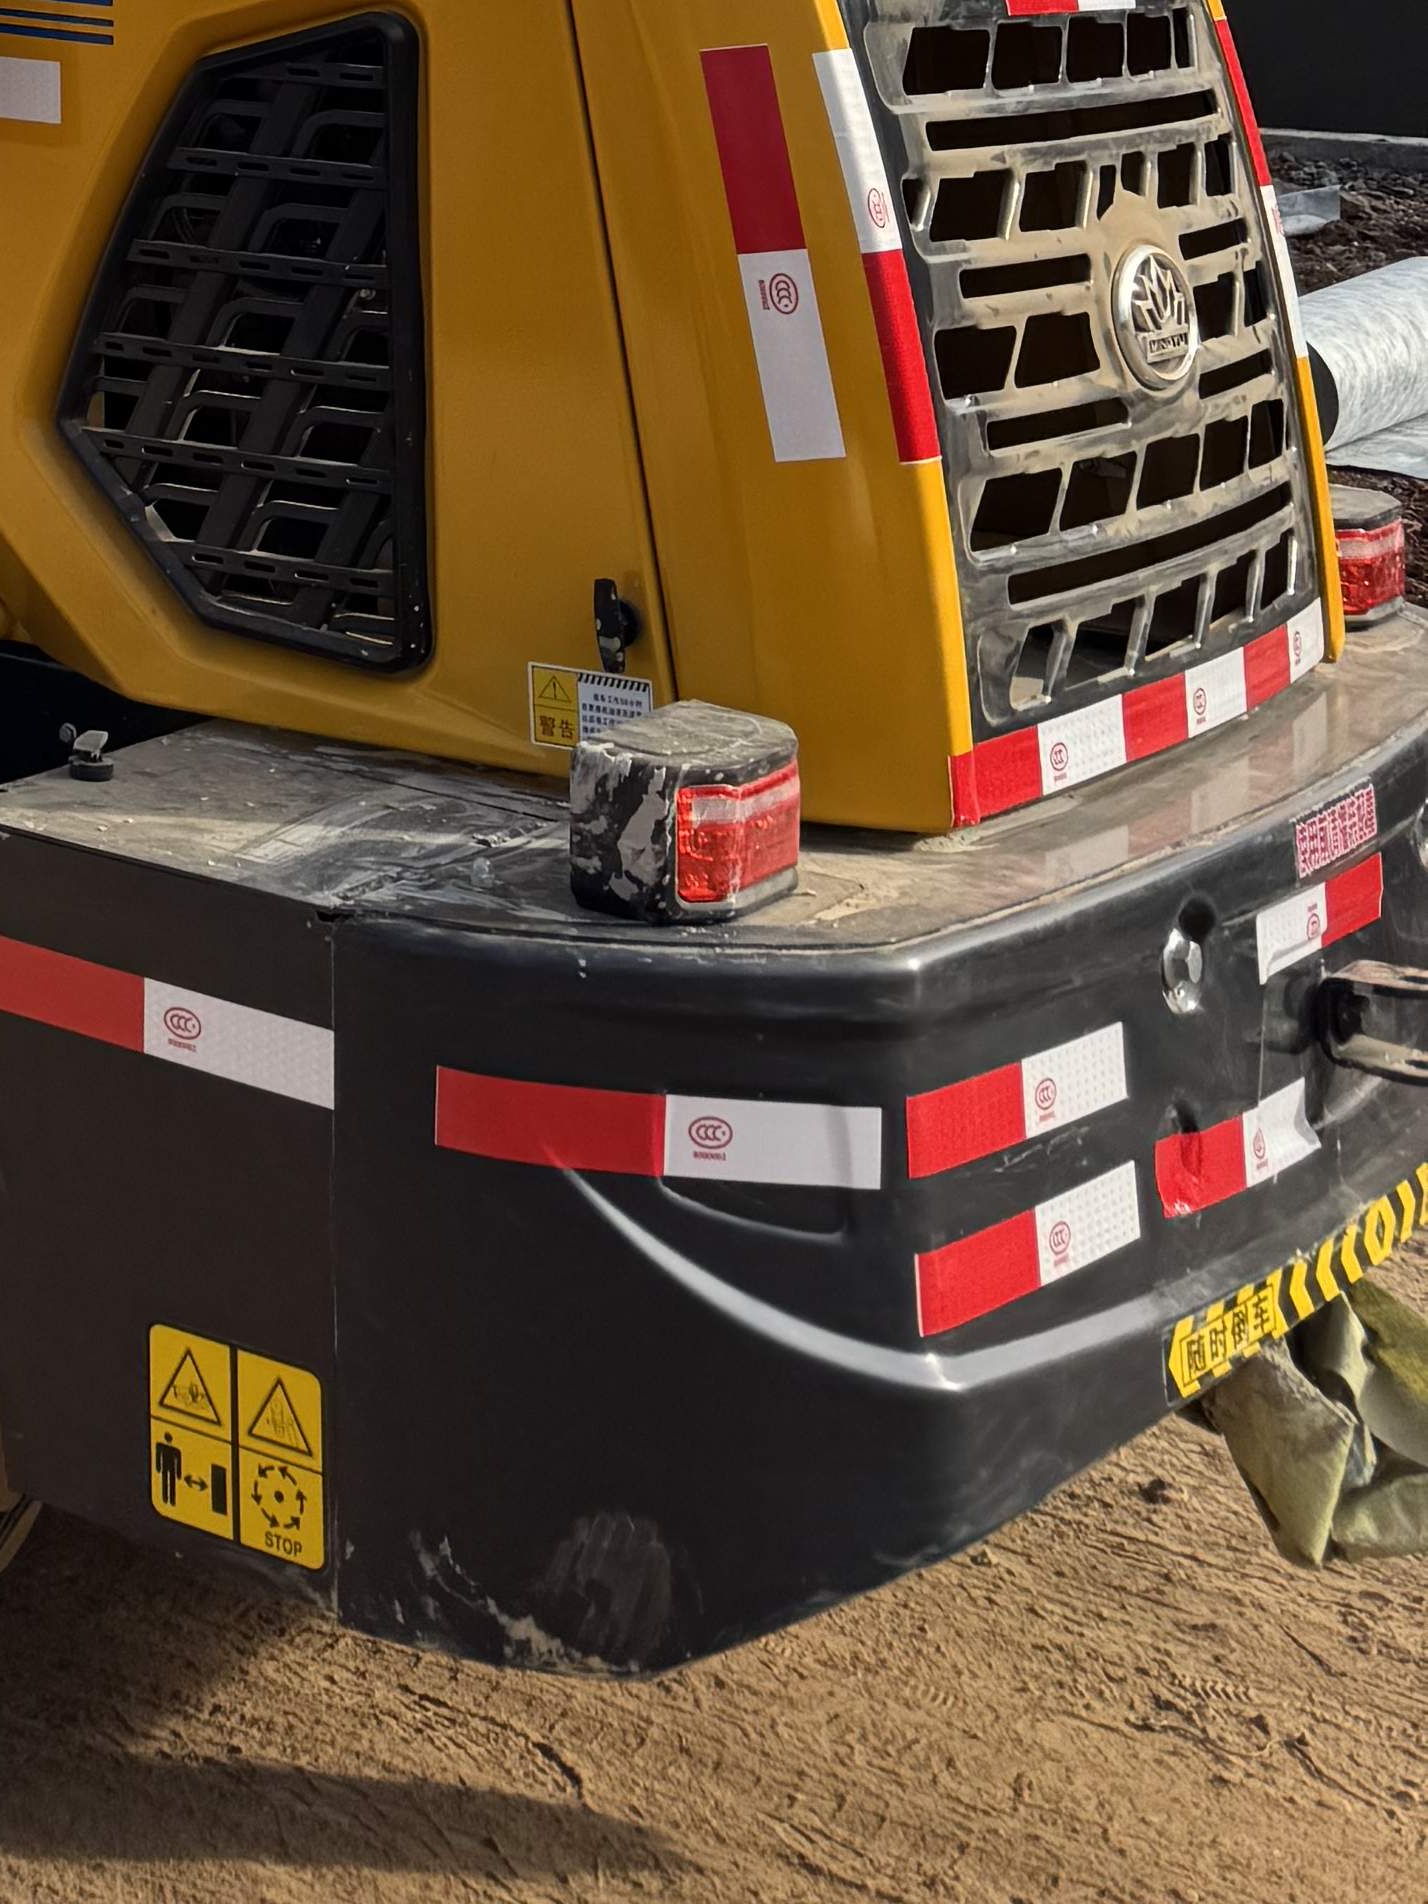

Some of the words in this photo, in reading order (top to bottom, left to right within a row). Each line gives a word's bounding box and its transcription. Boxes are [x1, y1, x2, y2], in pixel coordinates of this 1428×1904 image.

[539, 715, 573, 739] 警告
[1187, 1295, 1271, 1374] 随时倒车
[265, 1531, 302, 1556] STOP
